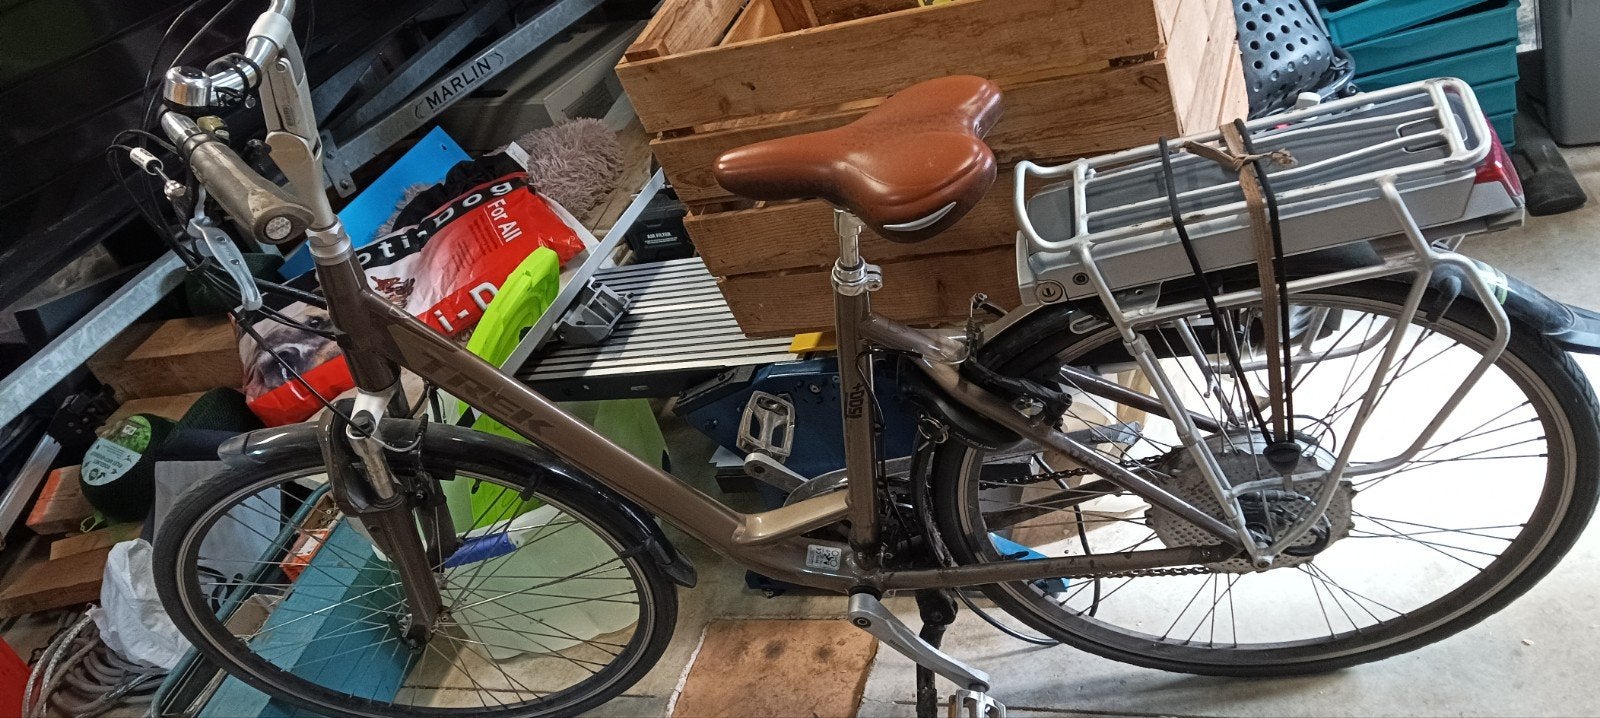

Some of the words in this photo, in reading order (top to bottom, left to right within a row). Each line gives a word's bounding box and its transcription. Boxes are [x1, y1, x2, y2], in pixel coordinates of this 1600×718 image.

[425, 57, 491, 110] MARLIN
[487, 199, 508, 221] For
[498, 221, 522, 243] All
[420, 350, 557, 436] TREK
